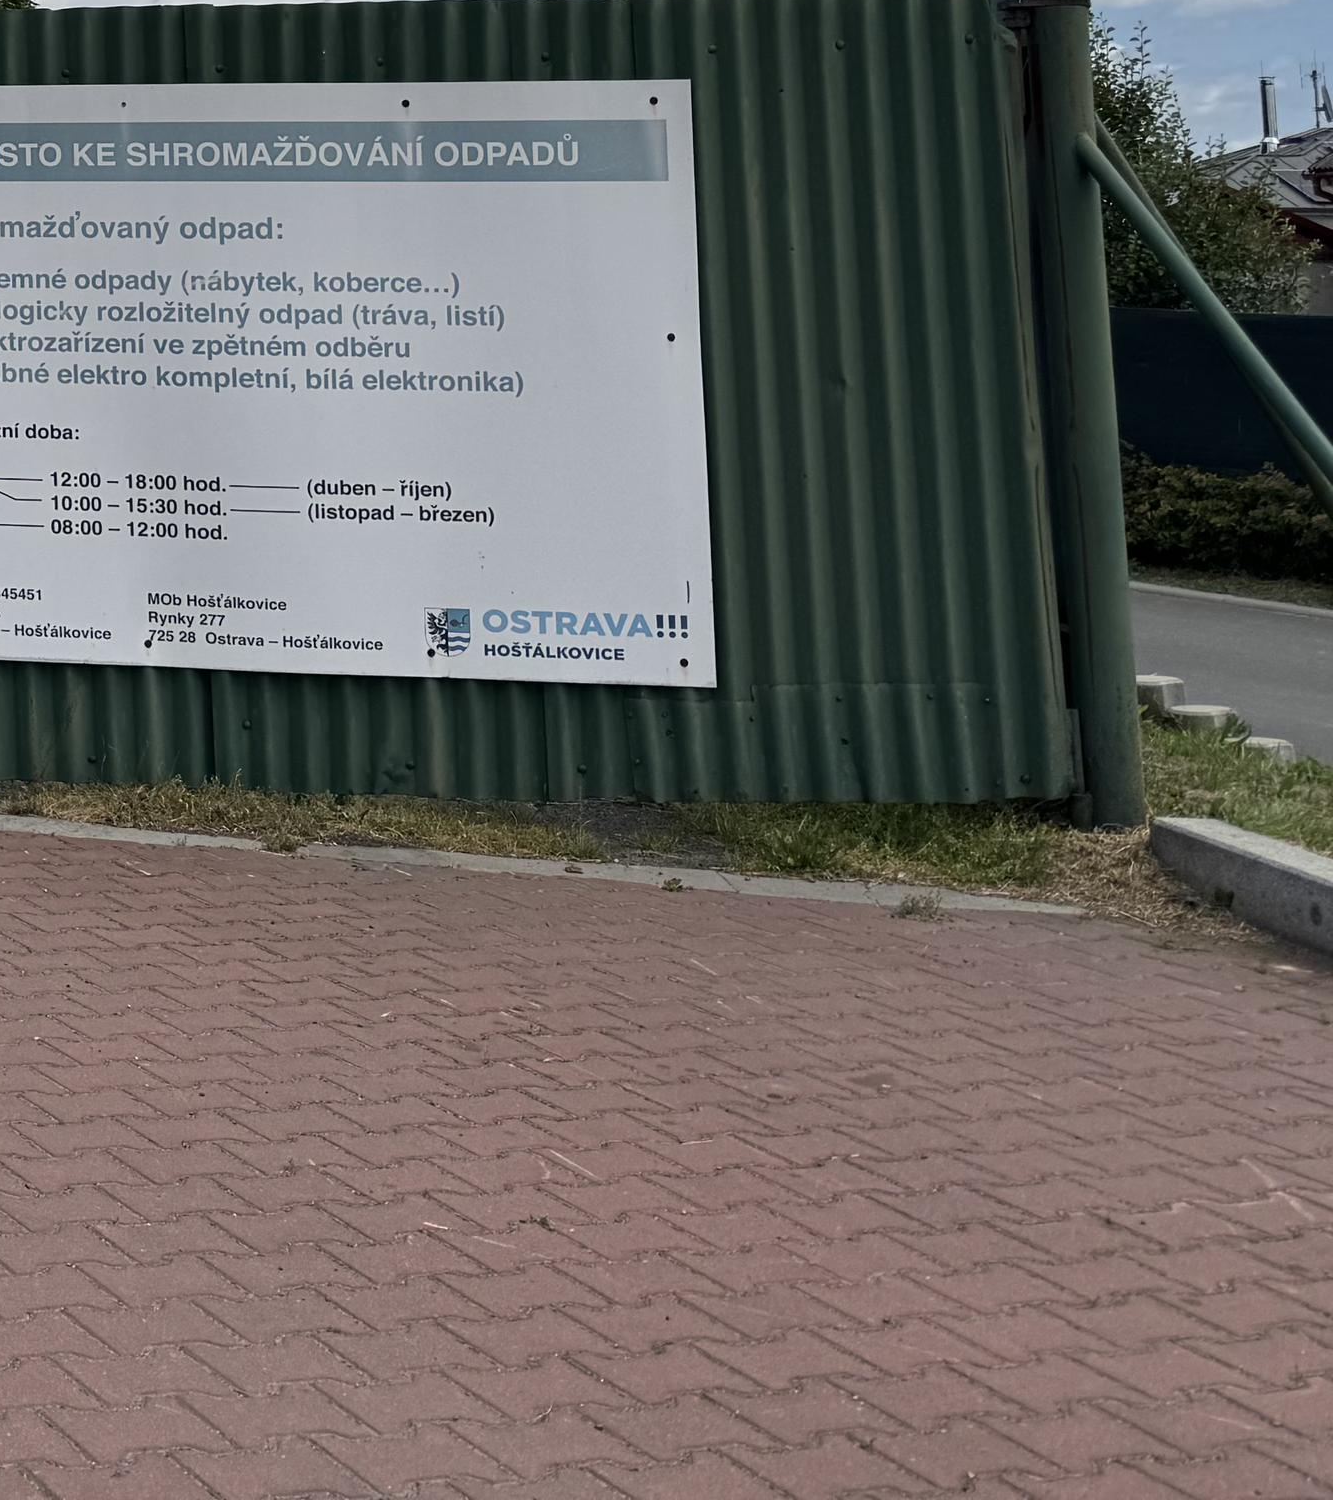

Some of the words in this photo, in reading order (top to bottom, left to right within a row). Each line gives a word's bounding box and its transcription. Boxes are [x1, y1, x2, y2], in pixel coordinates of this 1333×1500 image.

[72, 142, 117, 167] KE
[125, 135, 424, 167] SHROMAŽĎOVÁNÍ
[434, 133, 579, 167] ODPADŮ
[179, 216, 283, 246] odpad:
[74, 269, 173, 297] odpady
[180, 269, 304, 298] (nábytek,
[96, 300, 251, 330] rozložitelný
[258, 302, 343, 331] odpad
[352, 303, 437, 331] (tráva,
[446, 304, 505, 332] listí)
[152, 338, 185, 355] ve
[191, 333, 307, 362] zpětném
[315, 334, 411, 359] odběru
[56, 363, 148, 387] elektro
[155, 364, 296, 394] kompletní,
[305, 367, 355, 390] bílá
[361, 368, 524, 398] elektronika)
[24, 423, 80, 441] doba:
[49, 471, 102, 489] 12:00
[124, 473, 177, 491] 18:00
[183, 475, 227, 493] hod.
[306, 478, 377, 499] (duben
[399, 479, 452, 502] říjen)
[50, 494, 103, 512] 10:00
[125, 496, 178, 515] 15:30
[183, 498, 227, 517] hod.
[307, 502, 395, 525] (listopad
[418, 504, 495, 528] březen)
[50, 518, 103, 536] 08:00
[126, 520, 179, 539] 12:00
[184, 522, 228, 541] hod.
[147, 592, 183, 607] MOb
[148, 610, 195, 629] Rynky
[198, 612, 226, 627] 277
[482, 608, 689, 640] OSTRAVA!!!
[148, 628, 175, 645] 725
[178, 629, 197, 644] 28
[205, 631, 265, 647] Ostrava
[483, 641, 626, 662] HOŠŤÁLKOVICE
